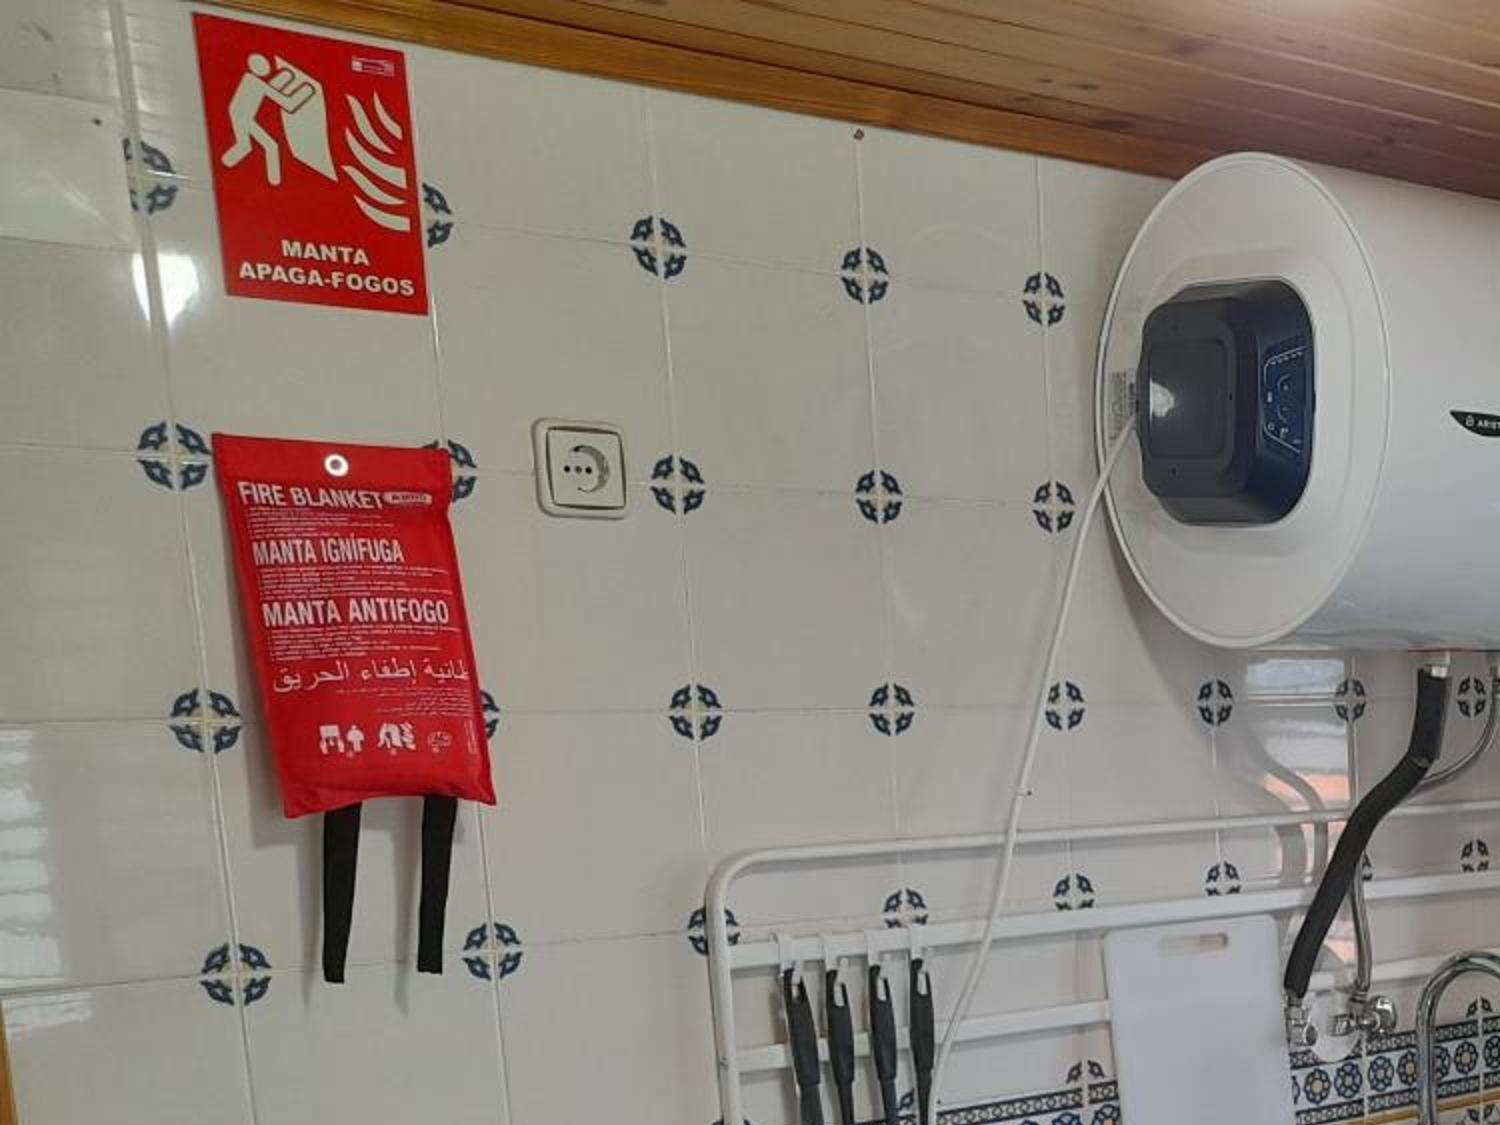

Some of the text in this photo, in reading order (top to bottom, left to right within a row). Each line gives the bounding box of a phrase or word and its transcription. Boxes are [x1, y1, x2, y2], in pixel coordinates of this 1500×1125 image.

[281, 239, 369, 265] MANTA
[239, 262, 415, 295] APAGA-FOGOS
[238, 482, 285, 505] FIRE
[289, 487, 383, 509] BLANKET
[253, 534, 404, 564] MANTA IGNÍFUGA
[262, 599, 449, 627] MANTA ANTIFOGO
[272, 659, 349, 693] الحريق
[360, 656, 417, 685] إطفاء
